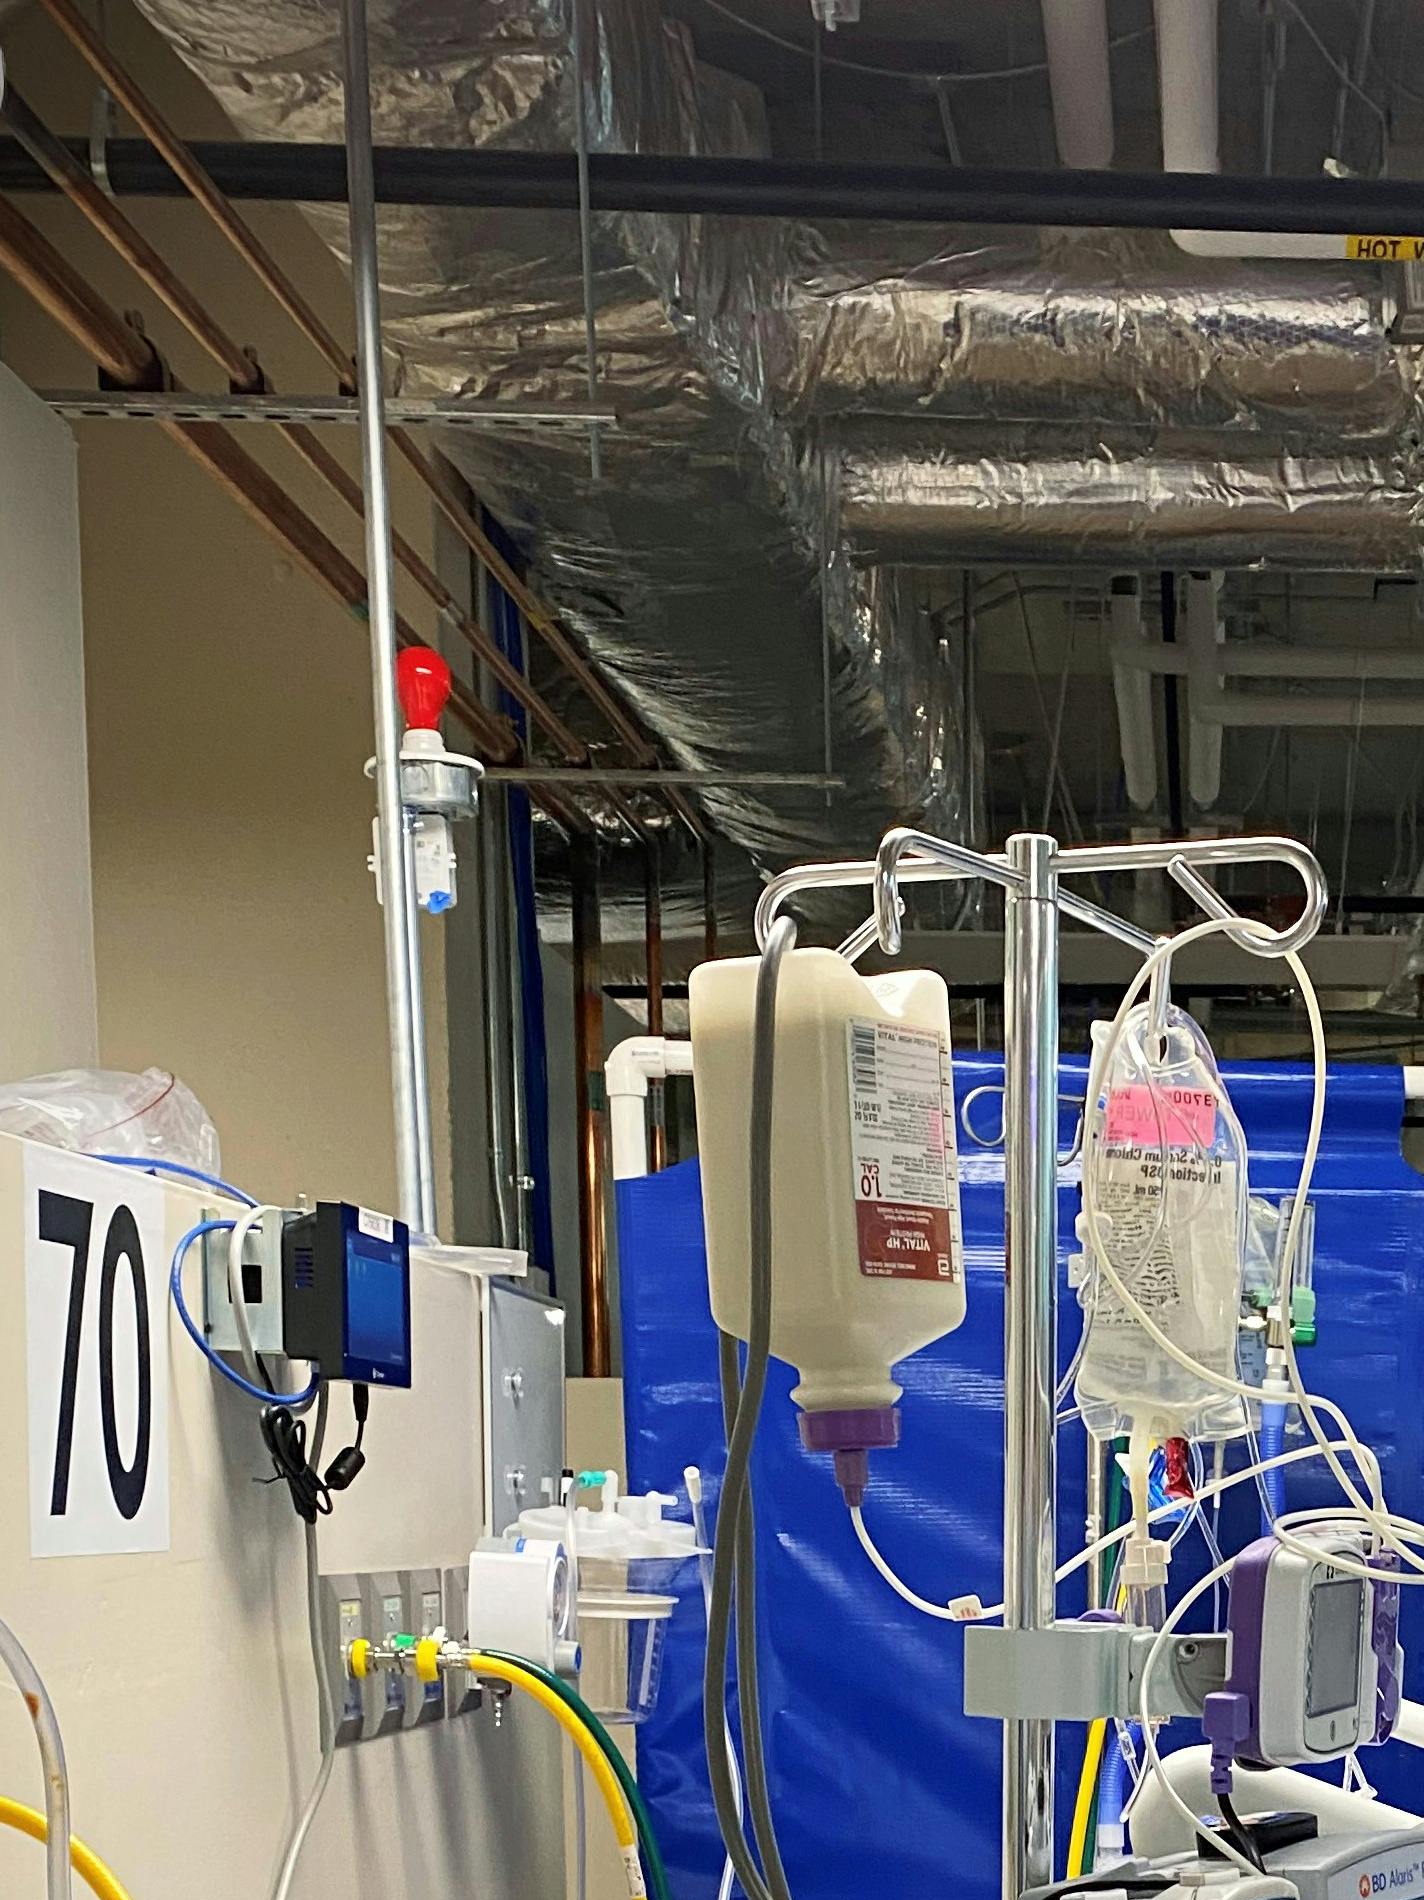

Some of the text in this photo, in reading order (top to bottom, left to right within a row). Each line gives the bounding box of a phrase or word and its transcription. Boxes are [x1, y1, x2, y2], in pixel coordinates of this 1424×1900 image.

[1357, 239, 1401, 259] HOT
[860, 1162, 880, 1175] CAL
[860, 1174, 882, 1198] 1.0
[886, 1237, 901, 1249] HP
[38, 1189, 151, 1520] 70
[1371, 1873, 1386, 1893] BD
